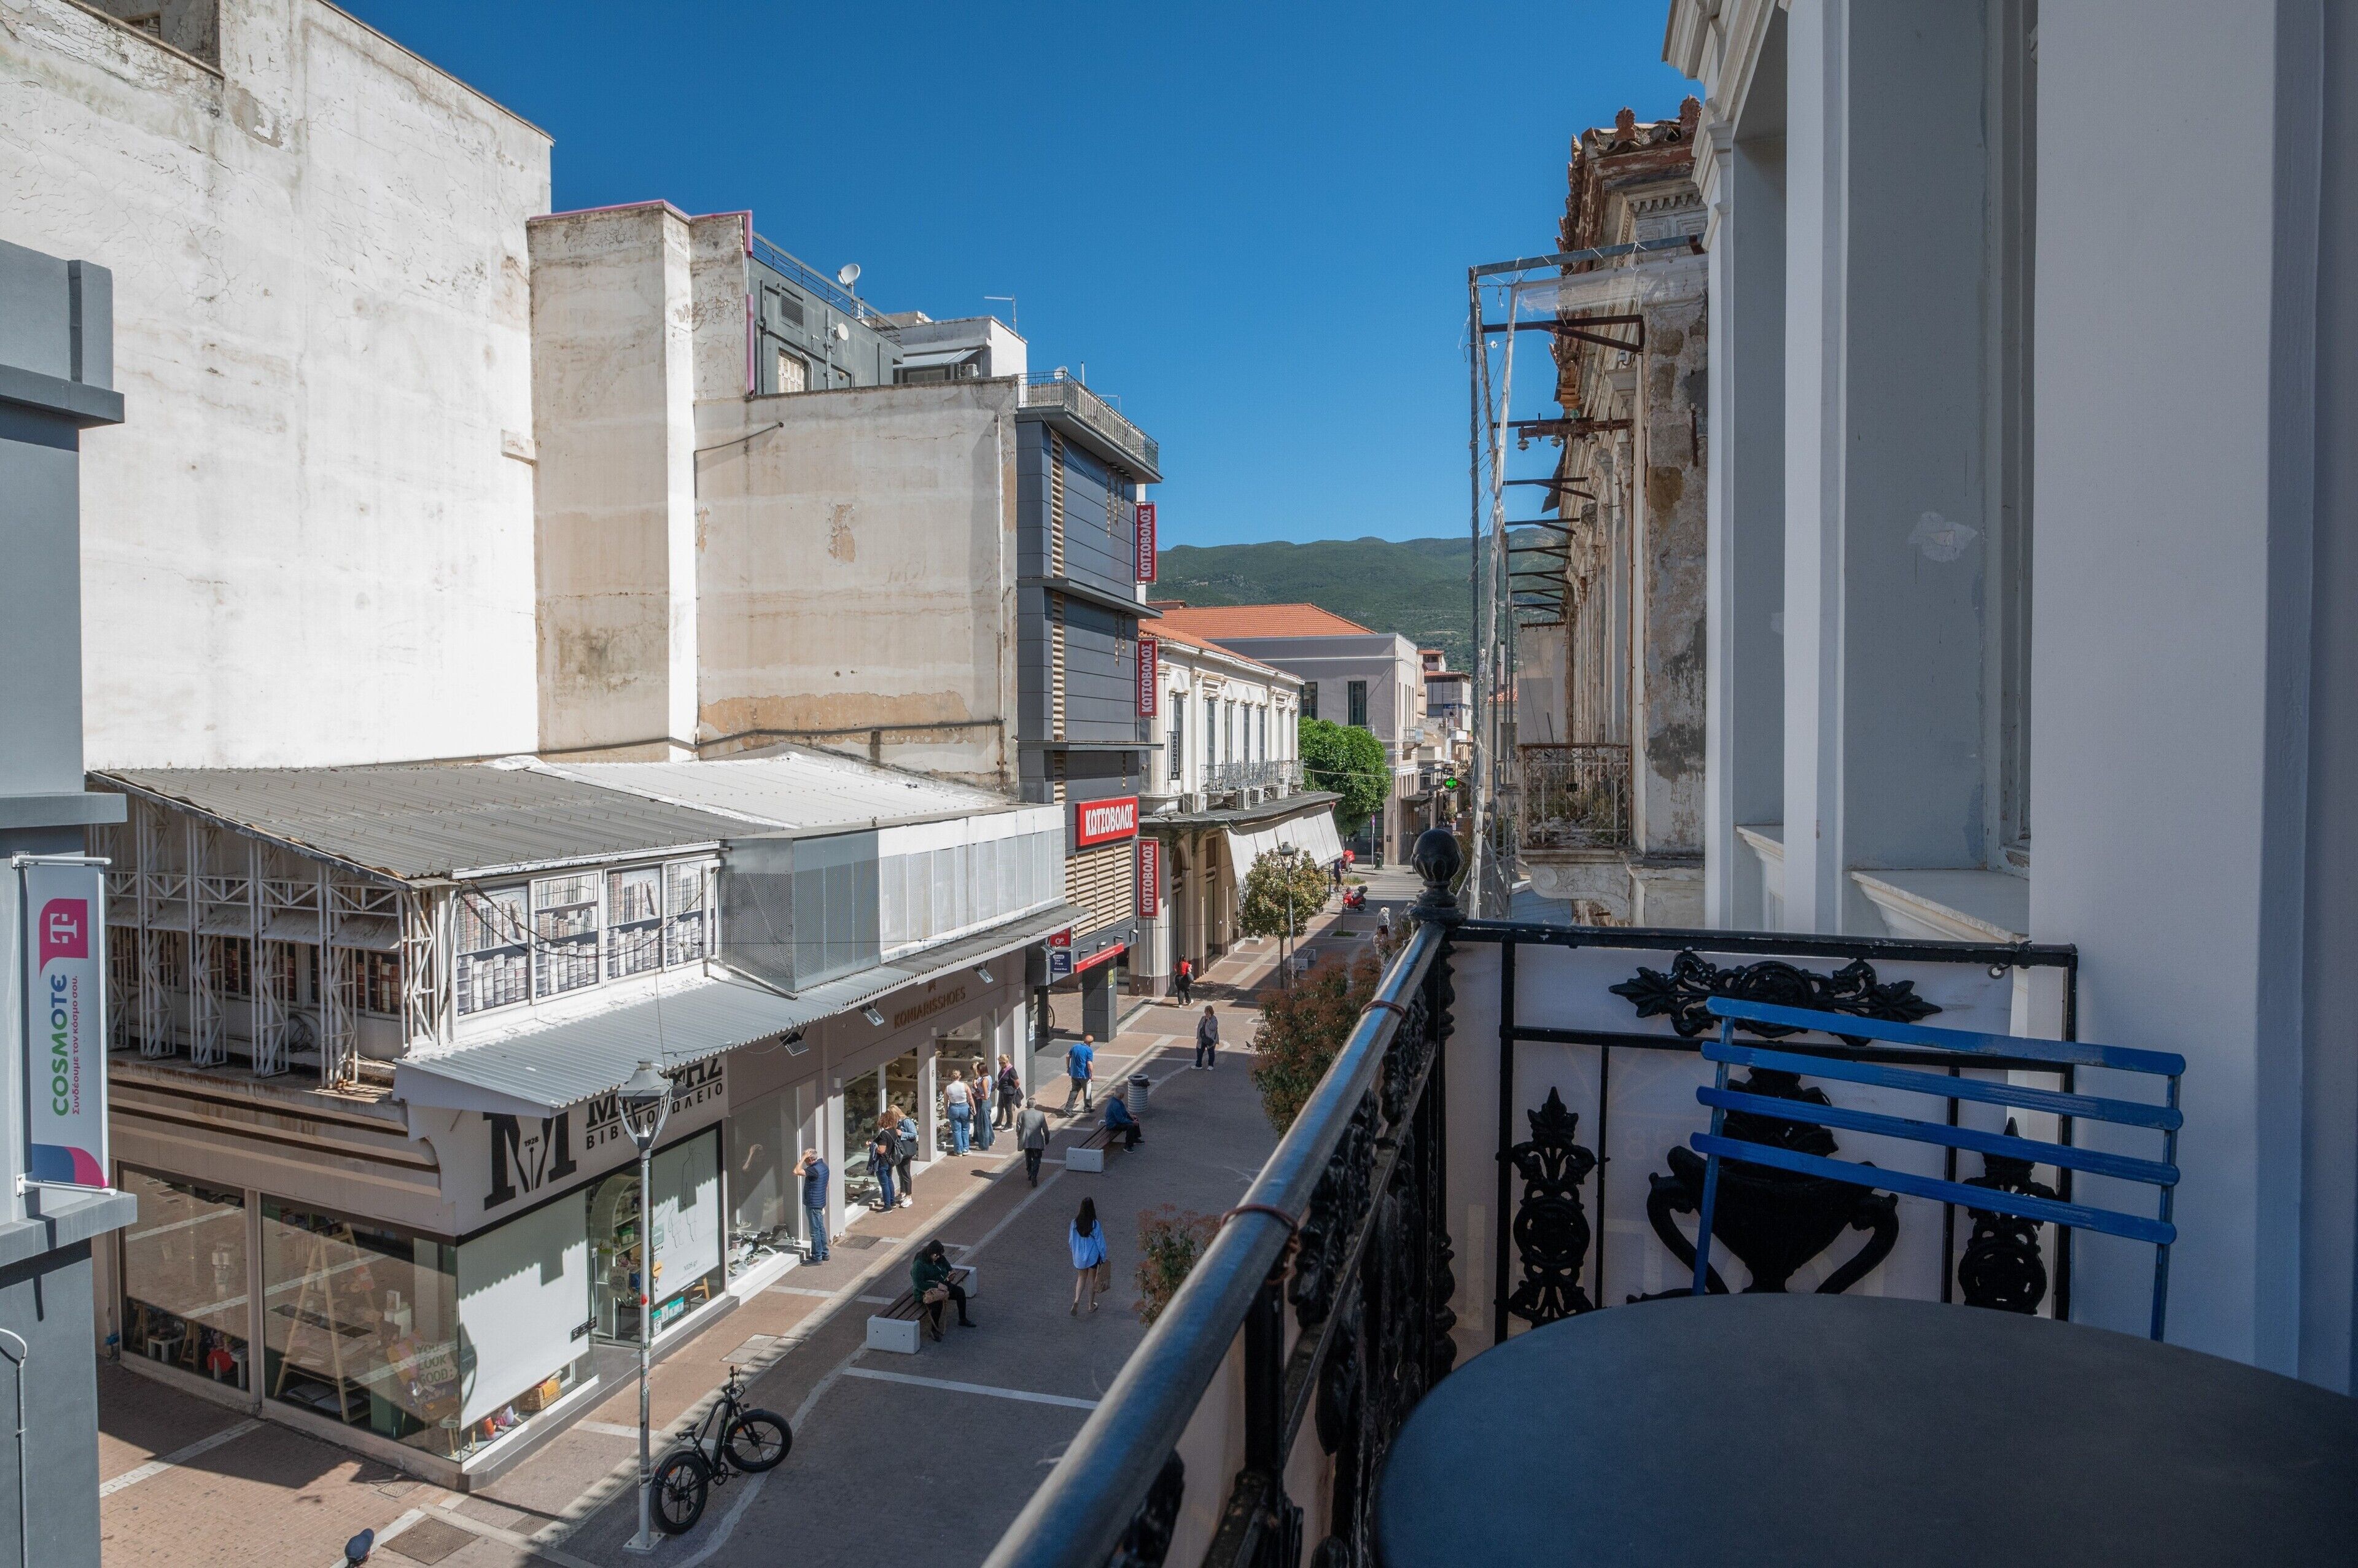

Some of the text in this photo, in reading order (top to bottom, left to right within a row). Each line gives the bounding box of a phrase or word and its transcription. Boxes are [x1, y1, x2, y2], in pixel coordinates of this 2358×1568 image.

[1140, 508, 1152, 578] ΚΩΤΣΟΒΟΛΟΣ
[1141, 644, 1153, 713] ΚΩΤΣΟΒΟΛΟΣ
[1085, 804, 1134, 837] ΚΩΤΣΟΒΟΛΟΣ
[1142, 844, 1154, 914] ΚΩΤΣΟΒΟΛΟΣ
[894, 986, 966, 1029] KONIARISSHOES
[50, 974, 69, 1116] COSMOTE
[72, 1056, 80, 1115] Συνδέουμε
[586, 1082, 723, 1150] ΒΙΒΛΙΟΩΛΕΙΟ
[524, 1136, 539, 1147] 1928
